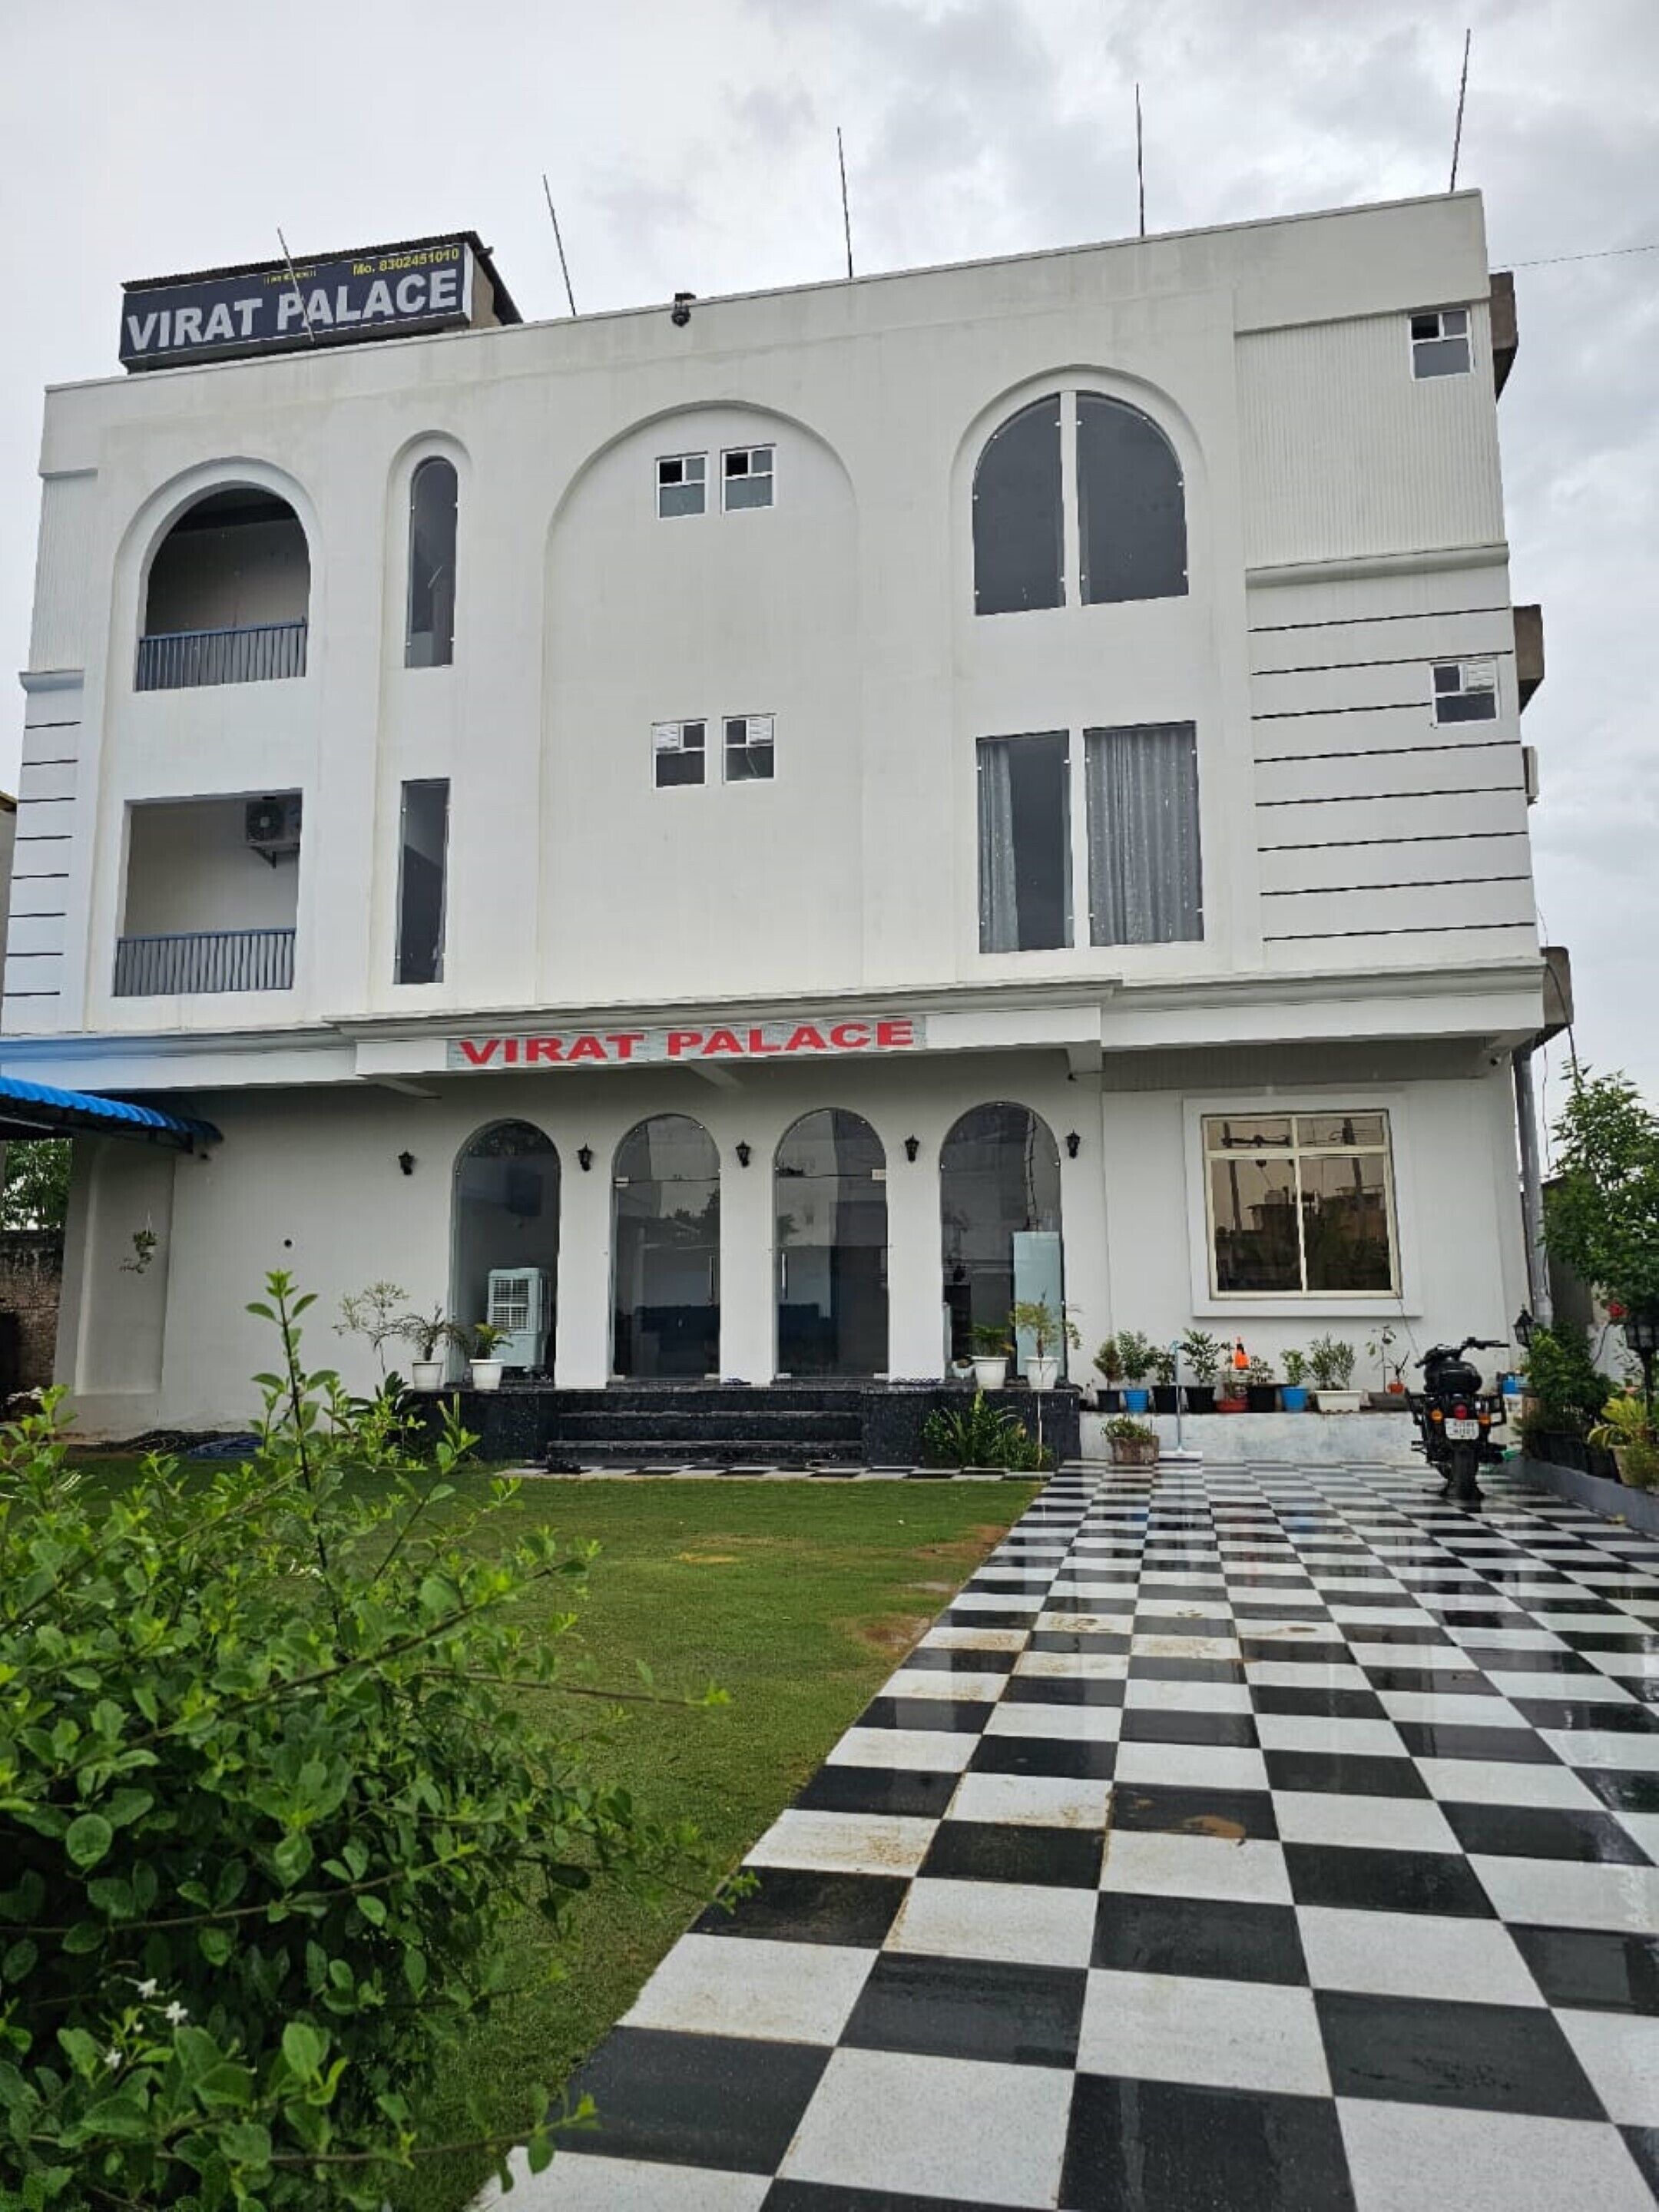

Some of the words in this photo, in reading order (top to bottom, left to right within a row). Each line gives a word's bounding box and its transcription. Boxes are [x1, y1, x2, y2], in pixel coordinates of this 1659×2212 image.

[126, 297, 263, 352] VIRAT
[276, 268, 459, 331] PALACE
[460, 1034, 644, 1065] VIRAT
[667, 1020, 915, 1056] PALACE
